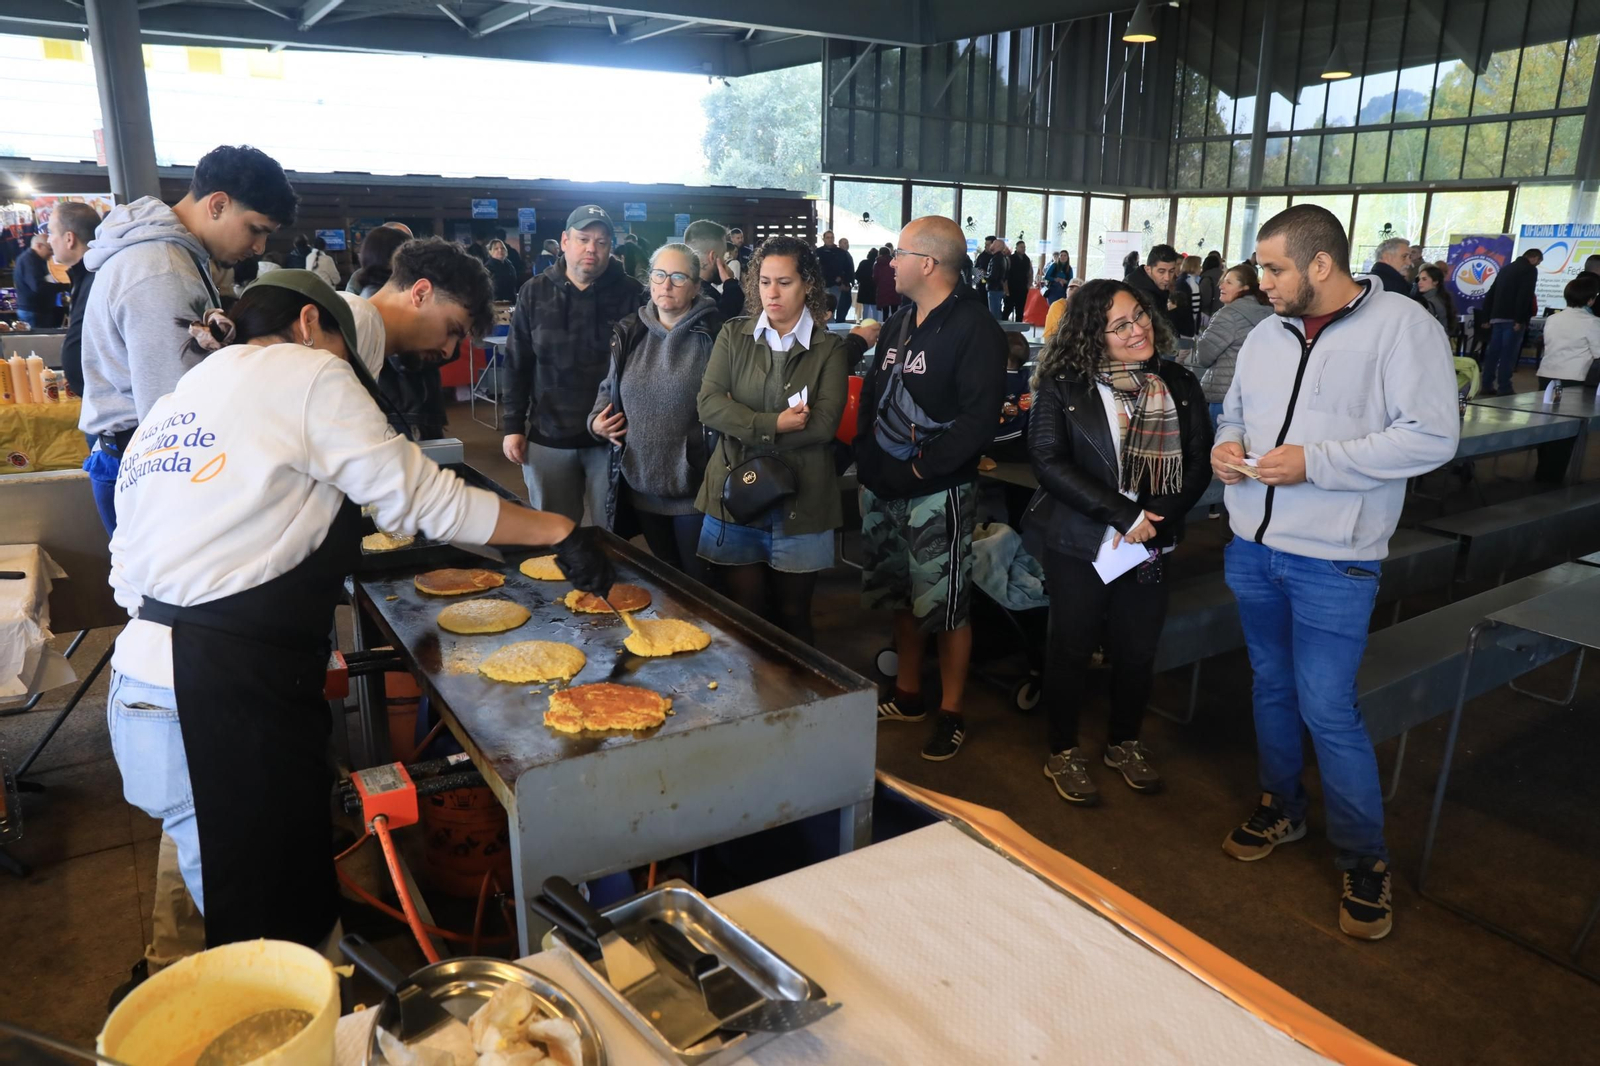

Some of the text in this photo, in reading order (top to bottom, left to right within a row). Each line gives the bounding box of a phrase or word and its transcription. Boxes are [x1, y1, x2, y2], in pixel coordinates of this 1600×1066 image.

[1524, 224, 1554, 237] OFICINA
[1557, 224, 1568, 237] DE
[881, 347, 927, 375] FLA
[161, 411, 196, 431] rico
[183, 426, 216, 448] de
